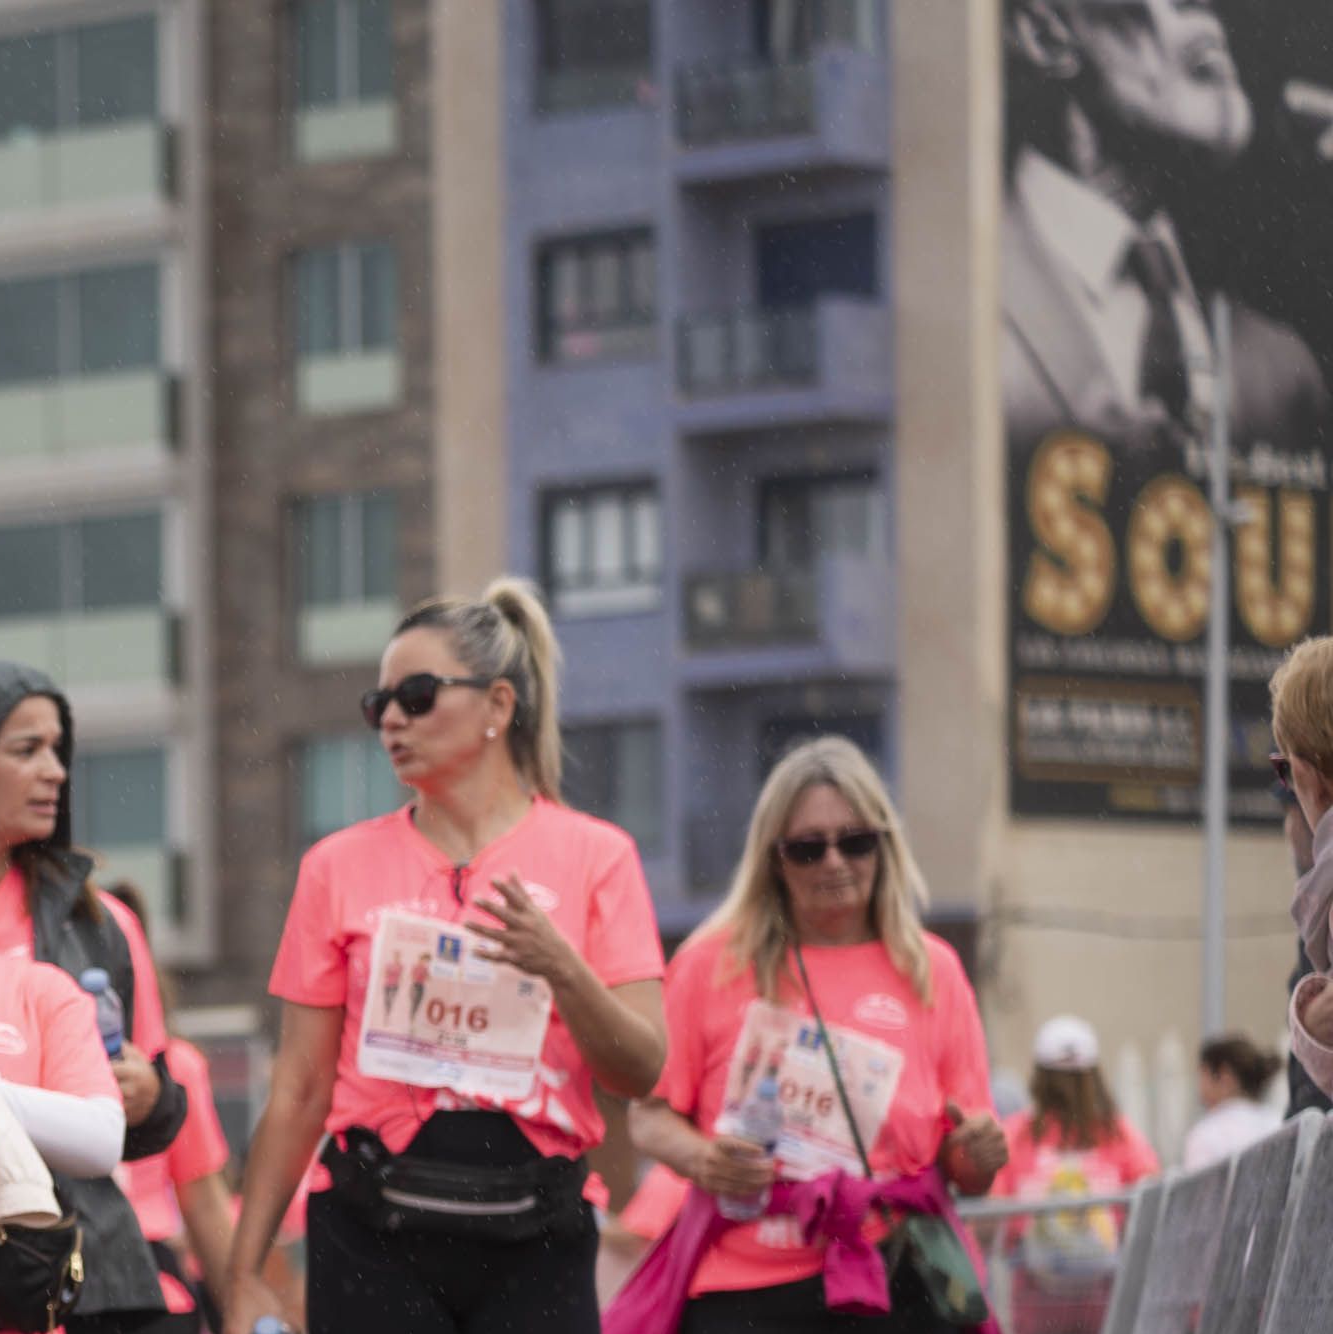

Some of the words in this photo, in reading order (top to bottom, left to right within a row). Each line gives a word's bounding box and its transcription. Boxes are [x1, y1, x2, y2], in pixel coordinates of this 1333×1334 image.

[1023, 430, 1333, 648] SOU
[426, 997, 489, 1034] 016
[779, 1078, 832, 1118] 016
